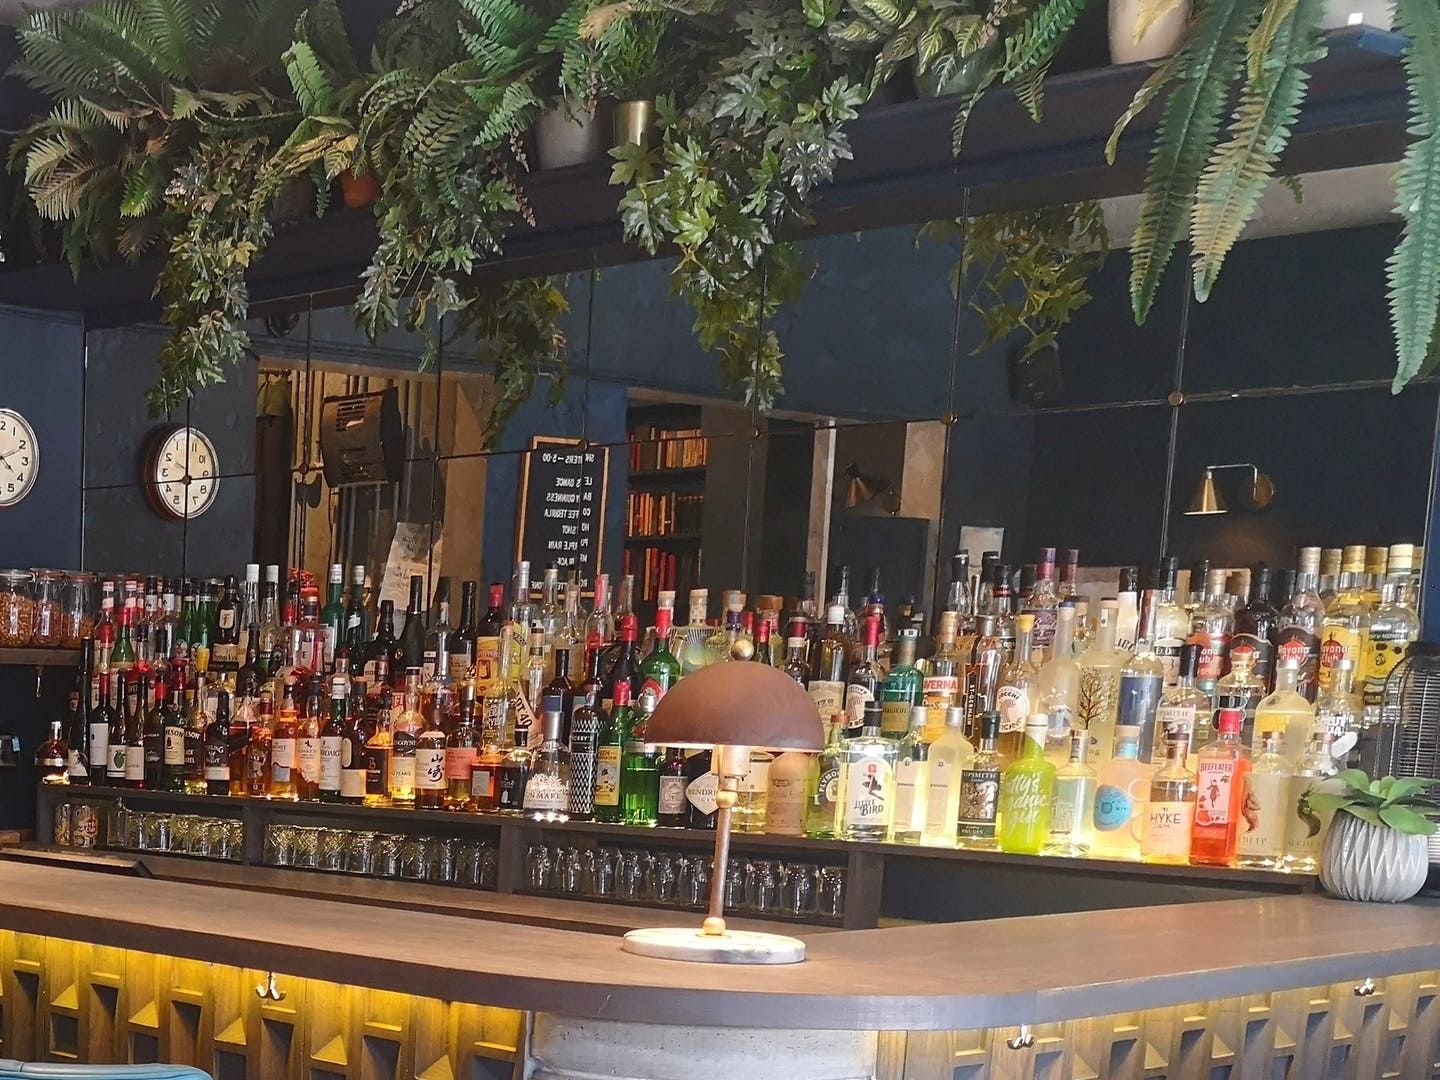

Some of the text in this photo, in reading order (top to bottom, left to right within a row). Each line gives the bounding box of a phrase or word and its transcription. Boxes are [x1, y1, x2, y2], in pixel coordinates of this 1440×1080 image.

[12, 426, 16, 436] 1
[19, 440, 26, 450] 2
[21, 457, 28, 466] 3
[16, 472, 24, 482] 4
[7, 483, 15, 492] 5
[1321, 645, 1349, 653] avana
[1200, 762, 1233, 773] BEEFEATER
[818, 770, 838, 793] PLYMO
[687, 788, 718, 796] HENDRI
[860, 804, 884, 817] BIRD
[1150, 813, 1182, 824] HYKE
